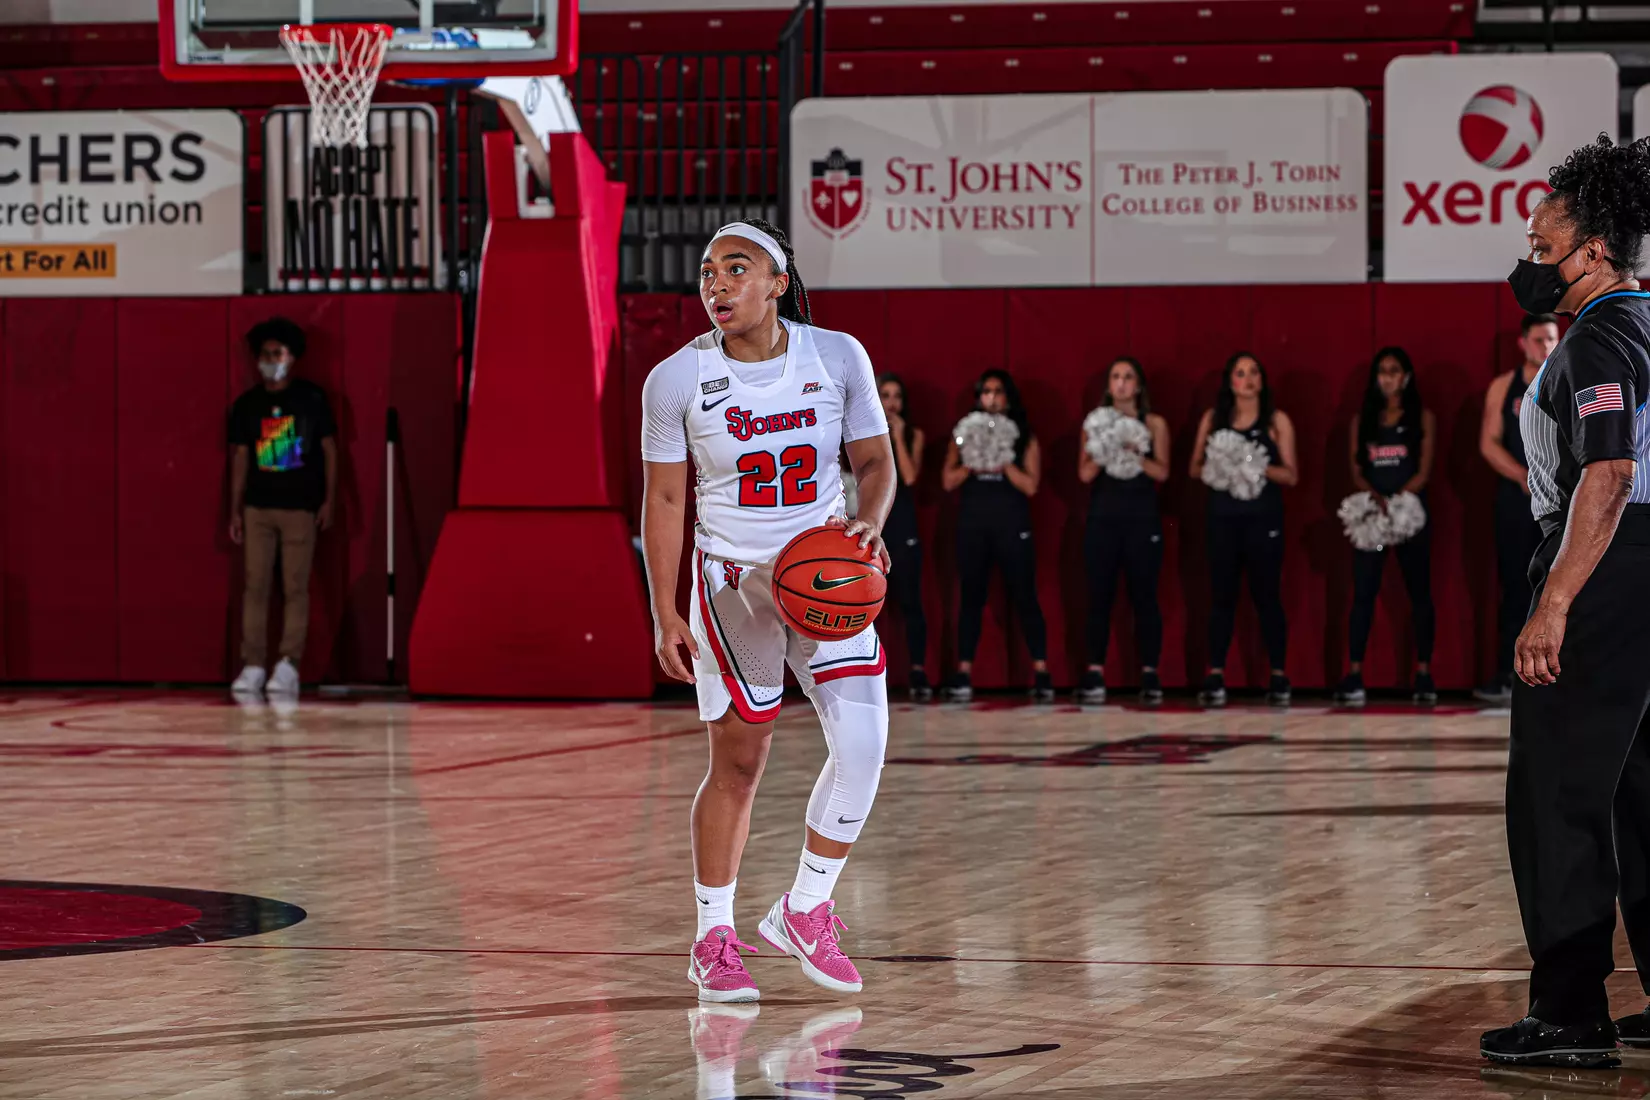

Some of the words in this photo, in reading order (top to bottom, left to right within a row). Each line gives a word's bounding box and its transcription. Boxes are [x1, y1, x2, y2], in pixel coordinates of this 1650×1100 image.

[885, 156, 936, 195] ST.
[941, 156, 1083, 204] JOHN'S
[1118, 163, 1164, 185] THE
[1172, 162, 1239, 184] PETER
[1242, 160, 1264, 189] J.
[1270, 160, 1341, 183] TOBIN
[0, 195, 89, 225] redit
[103, 195, 203, 225] union
[887, 204, 1080, 232] UNIVERSITY
[1101, 193, 1205, 216] COLLEGE
[1213, 196, 1242, 215] OF
[1252, 191, 1359, 214] BUSINESS
[287, 199, 334, 274] NO
[343, 199, 420, 274] HATE
[23, 251, 65, 271] For
[73, 250, 107, 271] All
[736, 443, 817, 507] 22
[804, 606, 868, 628] ELITE
